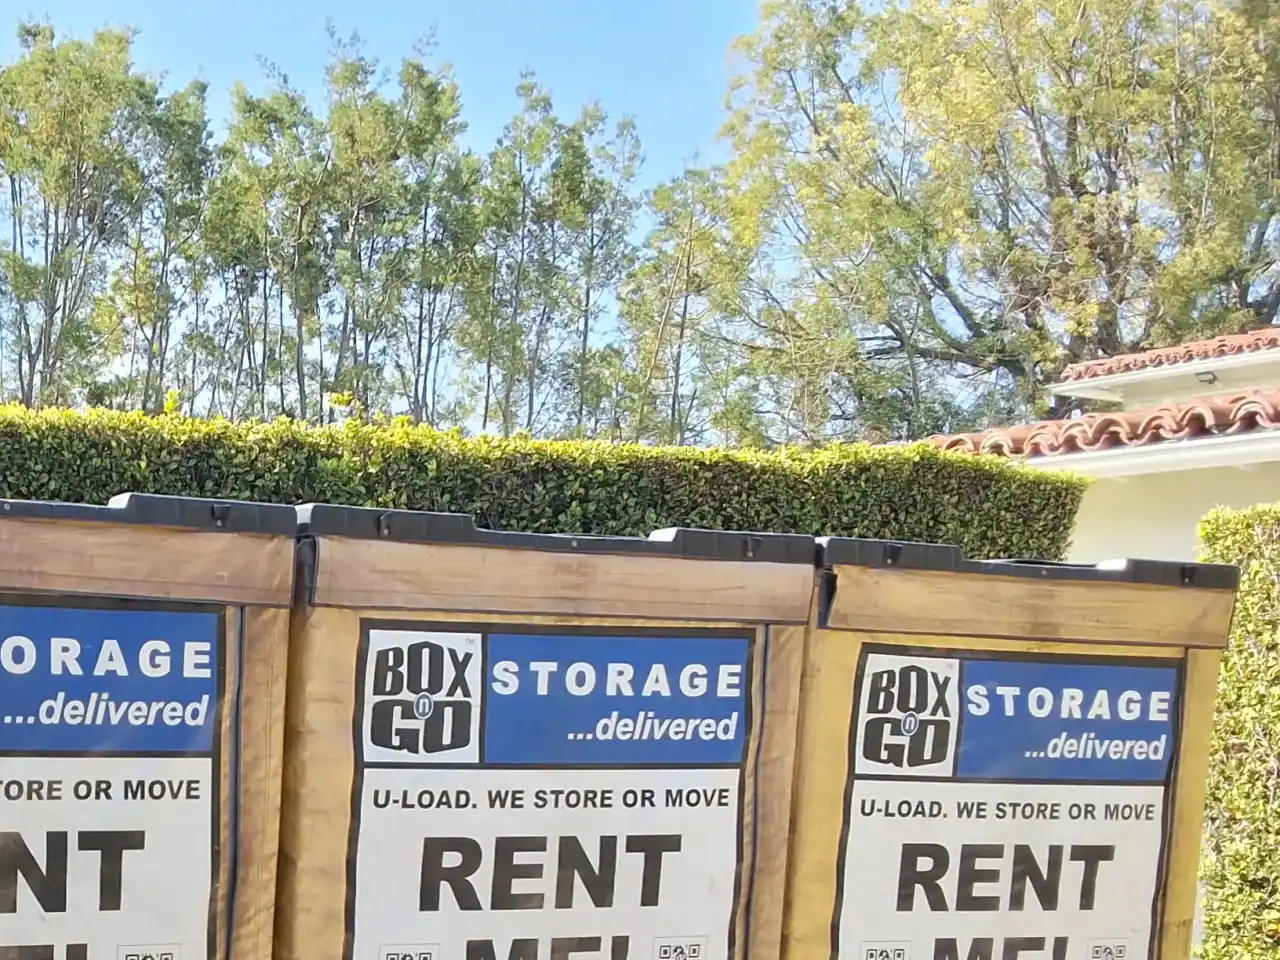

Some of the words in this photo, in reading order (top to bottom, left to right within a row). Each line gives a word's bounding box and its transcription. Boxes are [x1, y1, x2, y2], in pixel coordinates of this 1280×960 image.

[372, 640, 474, 698] BOX
[491, 660, 742, 697] STORAGE
[867, 664, 952, 717] BOX
[370, 699, 472, 755] GO
[967, 685, 1171, 721] STORAGE
[862, 716, 951, 768] GO
[72, 779, 113, 801] OR
[123, 779, 201, 800] MOVE
[372, 790, 478, 809] U-LOAD.
[487, 790, 525, 809] WE
[533, 789, 613, 809] STORE
[622, 789, 656, 808] OR
[664, 788, 730, 808] MOVE
[860, 799, 948, 819] U-LOAD.
[956, 801, 987, 819] WE
[995, 803, 1061, 820] STORE
[1069, 803, 1096, 820] OR
[1104, 804, 1156, 821] MOVE
[419, 834, 682, 912] RENT
[895, 843, 1116, 912] RENT
